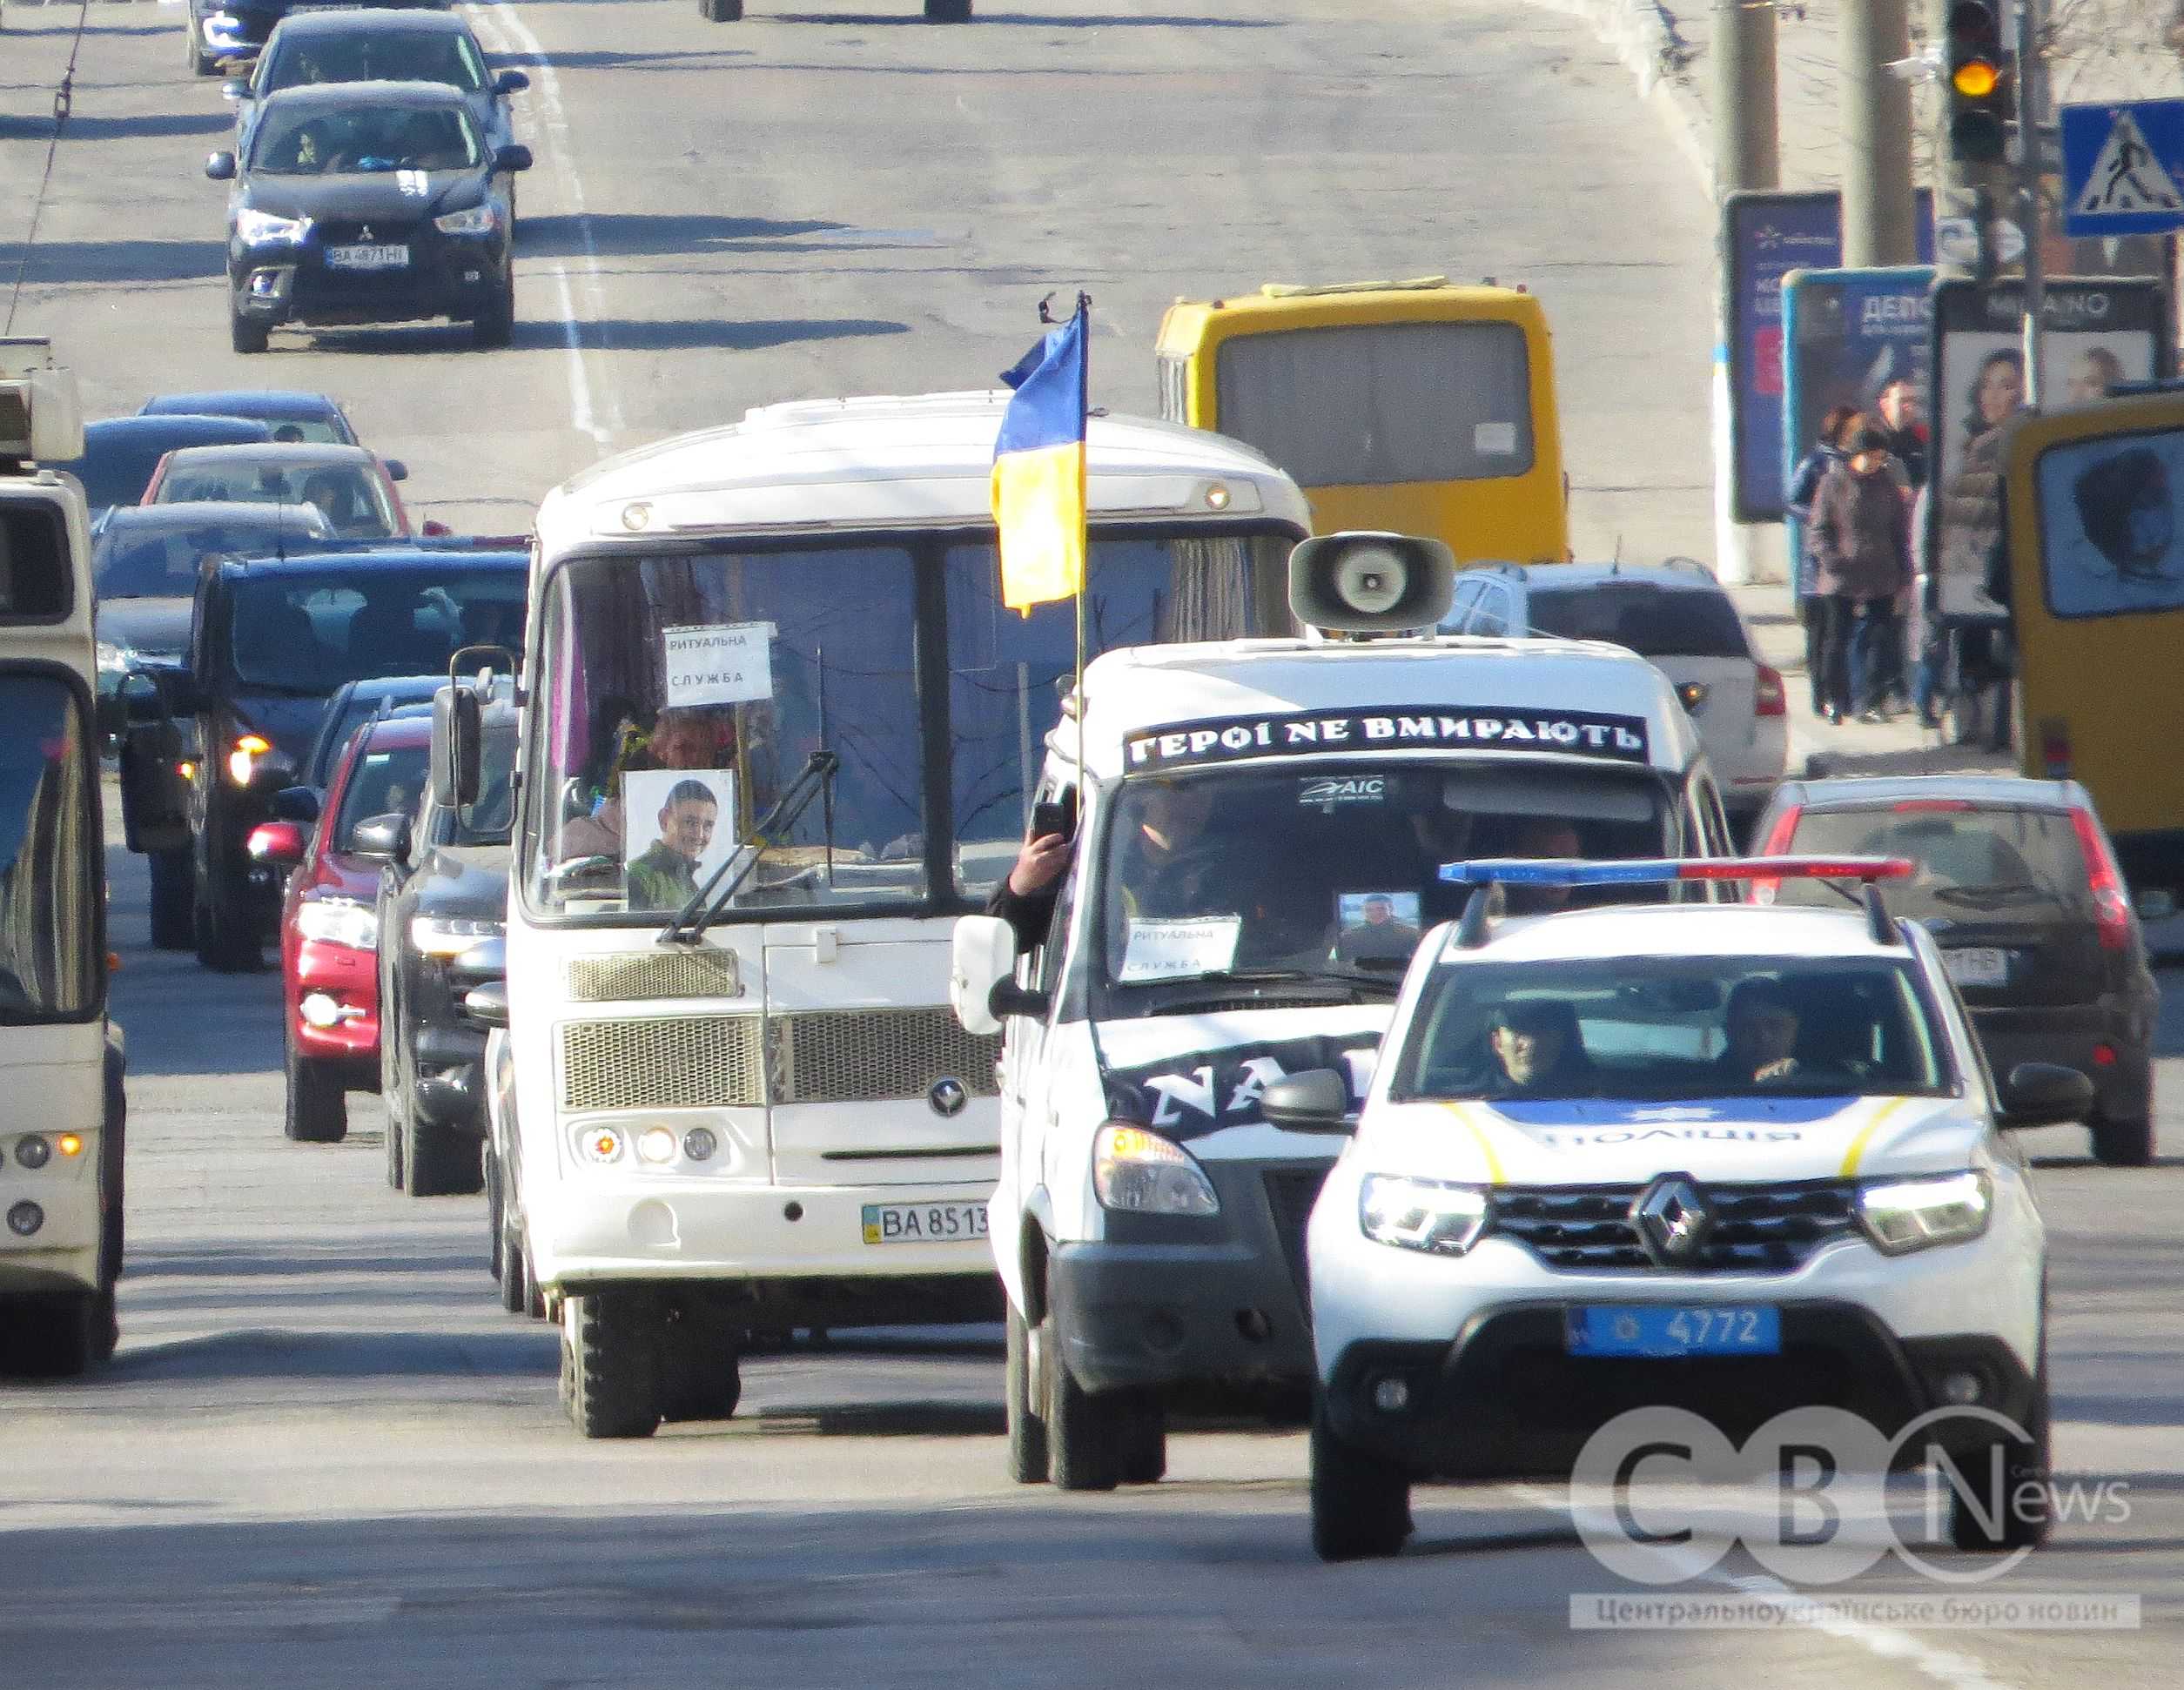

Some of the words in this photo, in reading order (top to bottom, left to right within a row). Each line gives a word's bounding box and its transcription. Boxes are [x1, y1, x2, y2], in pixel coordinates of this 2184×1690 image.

[669, 635, 747, 650] РИТУАЛЬНА
[671, 672, 743, 686] СЛУЖБА
[1361, 716, 1643, 749] ВМИРАЮТЬ
[1133, 929, 1214, 941] РИТУАЛЬНА
[1126, 959, 1201, 972] СЛУЖБА
[1545, 1129, 1802, 1146] ПОЛІЦІЯ
[883, 1209, 923, 1237] BA
[1666, 1308, 1758, 1344] 4772
